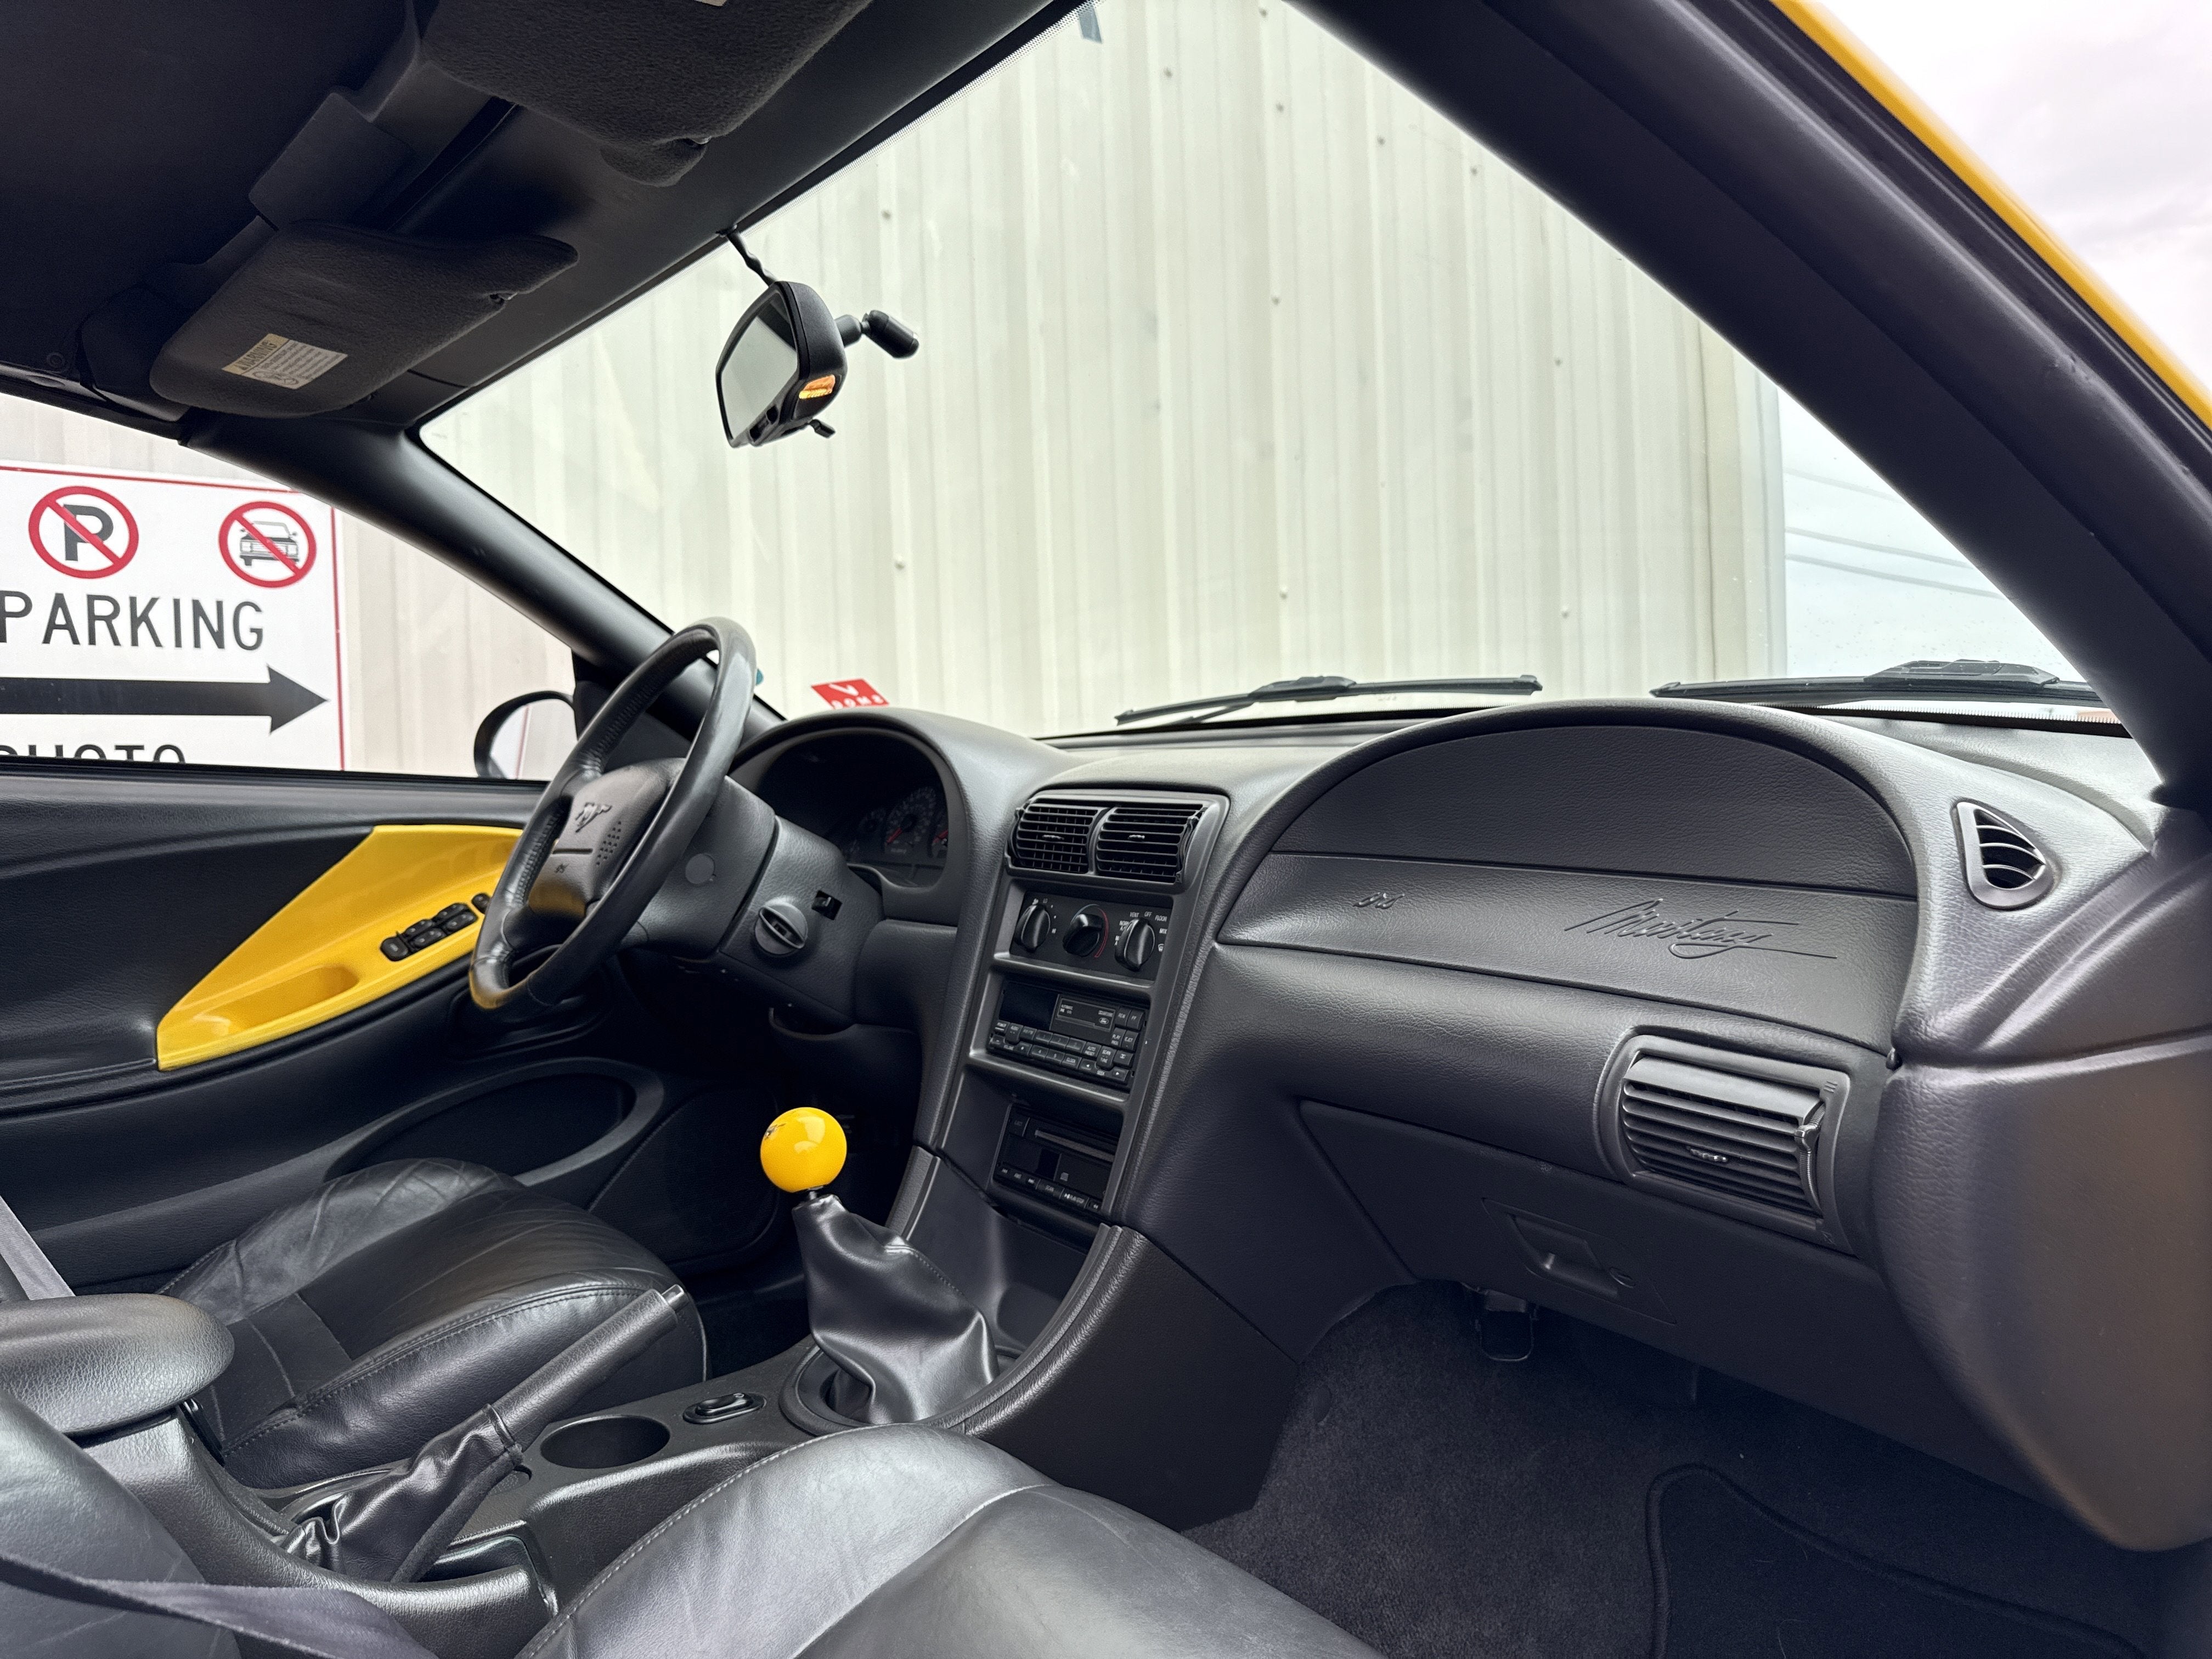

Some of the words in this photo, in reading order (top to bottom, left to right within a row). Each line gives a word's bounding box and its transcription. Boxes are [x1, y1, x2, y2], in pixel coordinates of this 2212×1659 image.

[234, 340, 279, 367] WARNING
[0, 590, 264, 651] PARKING
[1564, 897, 1837, 959] Mustang
